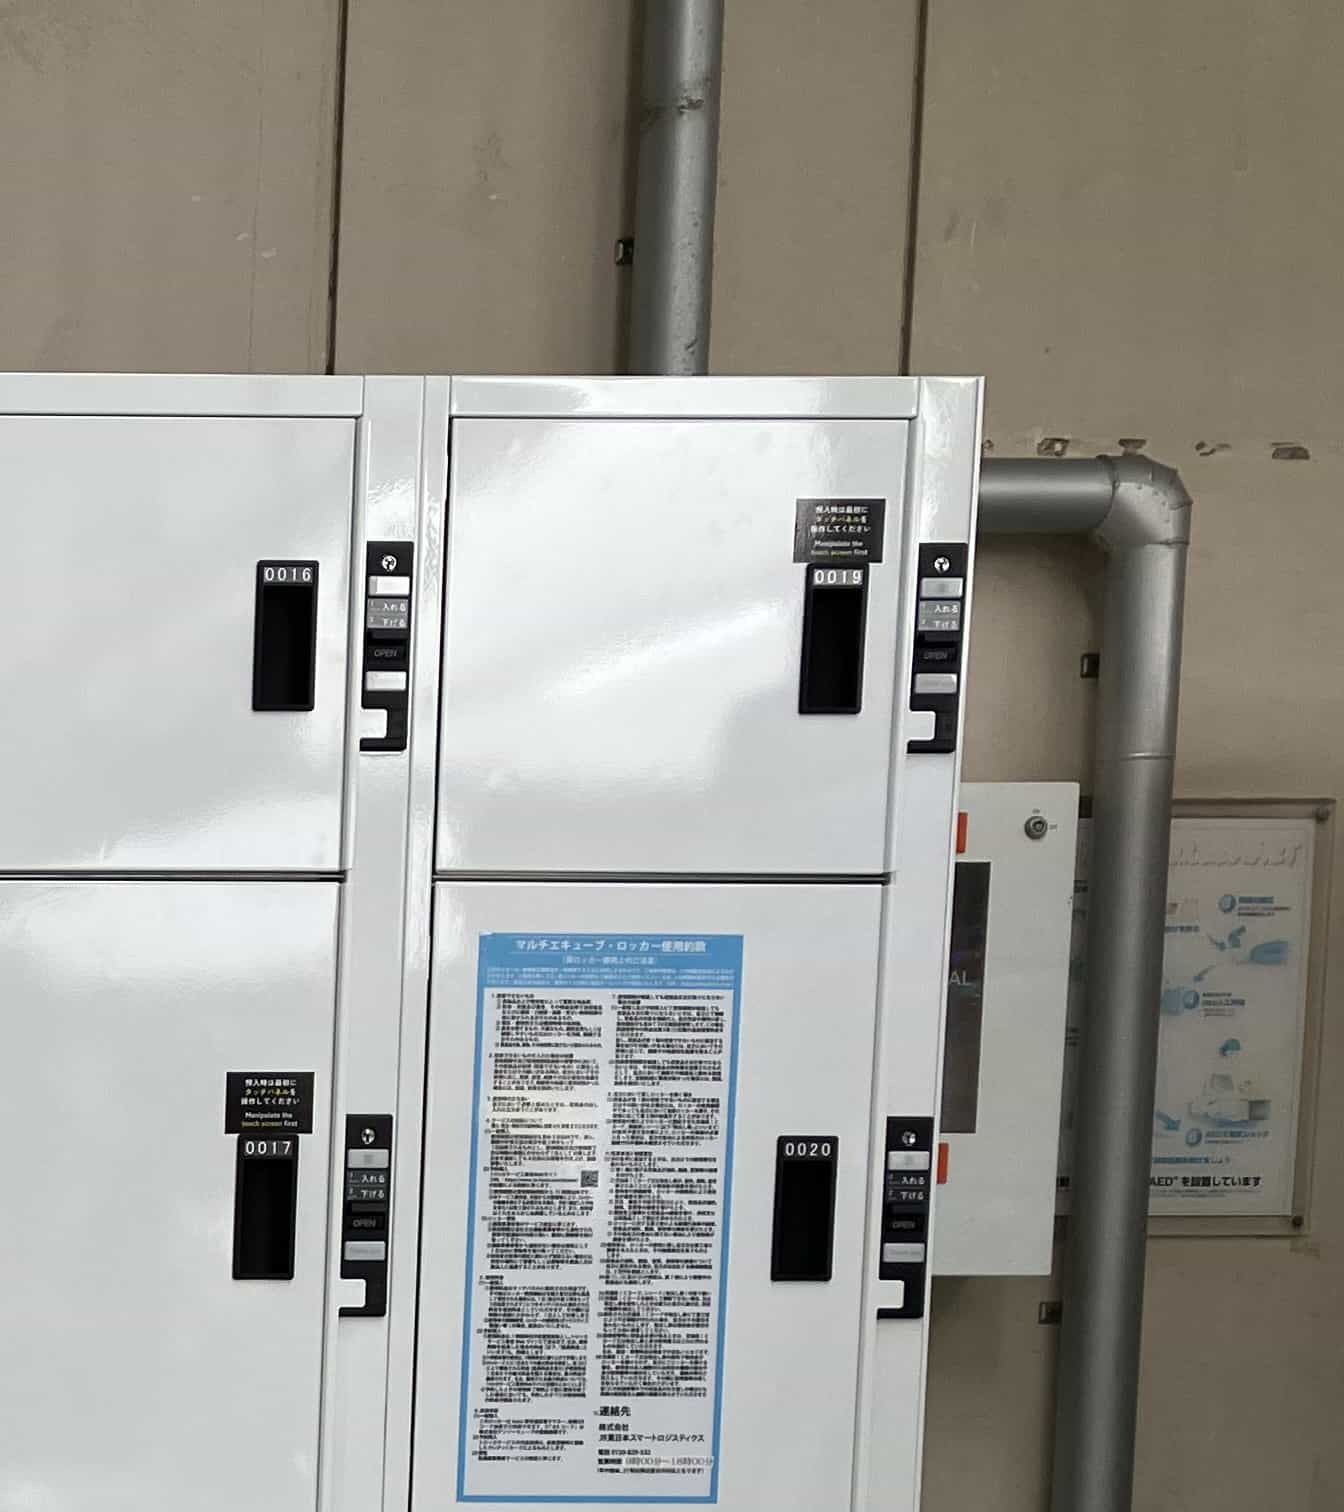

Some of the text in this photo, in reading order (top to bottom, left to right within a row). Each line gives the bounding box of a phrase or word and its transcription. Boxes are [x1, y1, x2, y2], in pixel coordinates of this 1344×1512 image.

[265, 568, 311, 581] 0016
[815, 570, 861, 584] 0019
[245, 1141, 291, 1154] 0017
[785, 1143, 831, 1156] 0020
